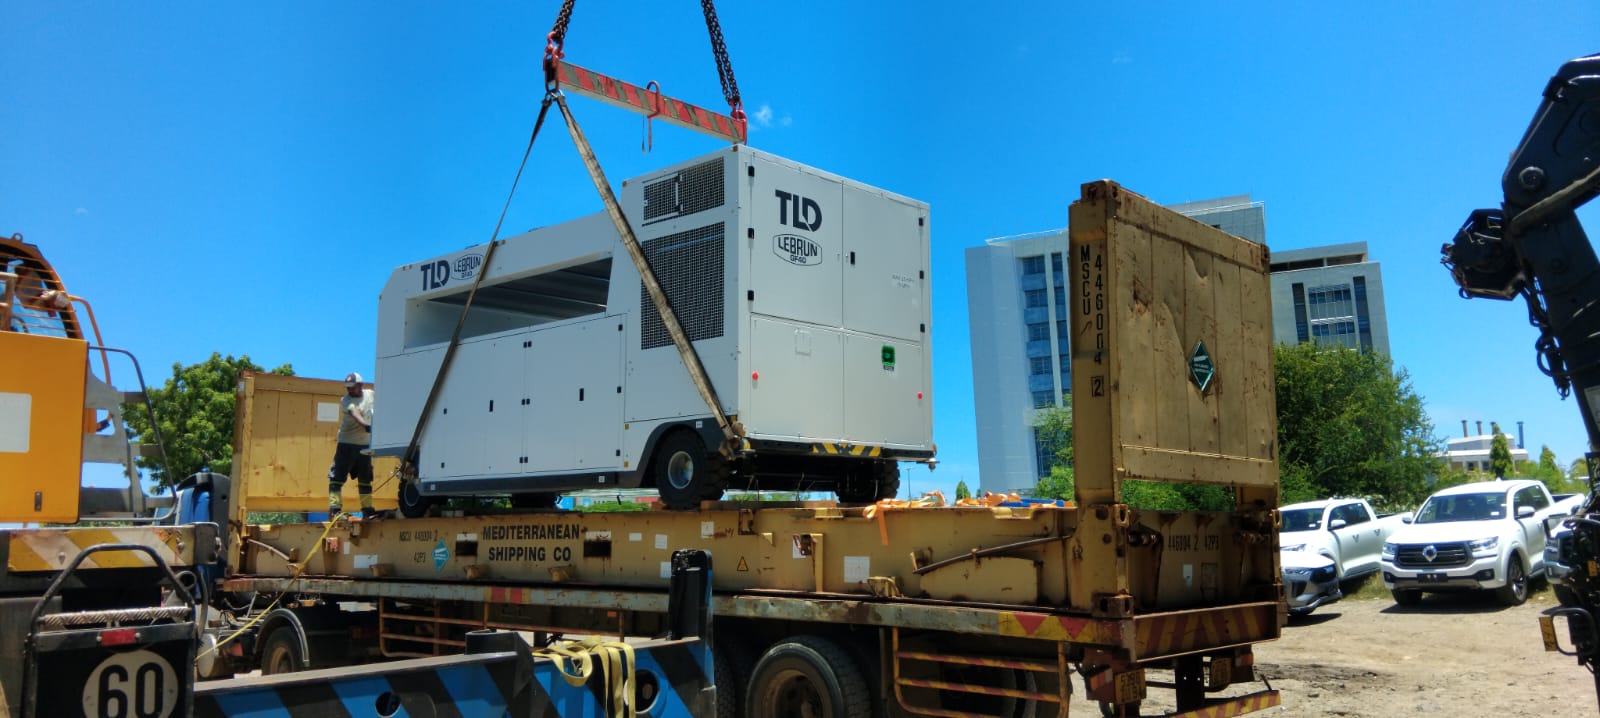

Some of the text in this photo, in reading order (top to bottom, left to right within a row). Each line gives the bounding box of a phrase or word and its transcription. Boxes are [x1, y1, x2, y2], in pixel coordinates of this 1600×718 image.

[775, 189, 822, 232] TLD
[778, 236, 818, 257] LEBRUN
[420, 260, 451, 291] TLD
[453, 256, 481, 273] LEBRUN
[1080, 244, 1091, 315] MSCU
[482, 524, 580, 541] MEDITERRANEAN
[488, 546, 572, 562] SHIPPING CO
[98, 662, 164, 718] 60
